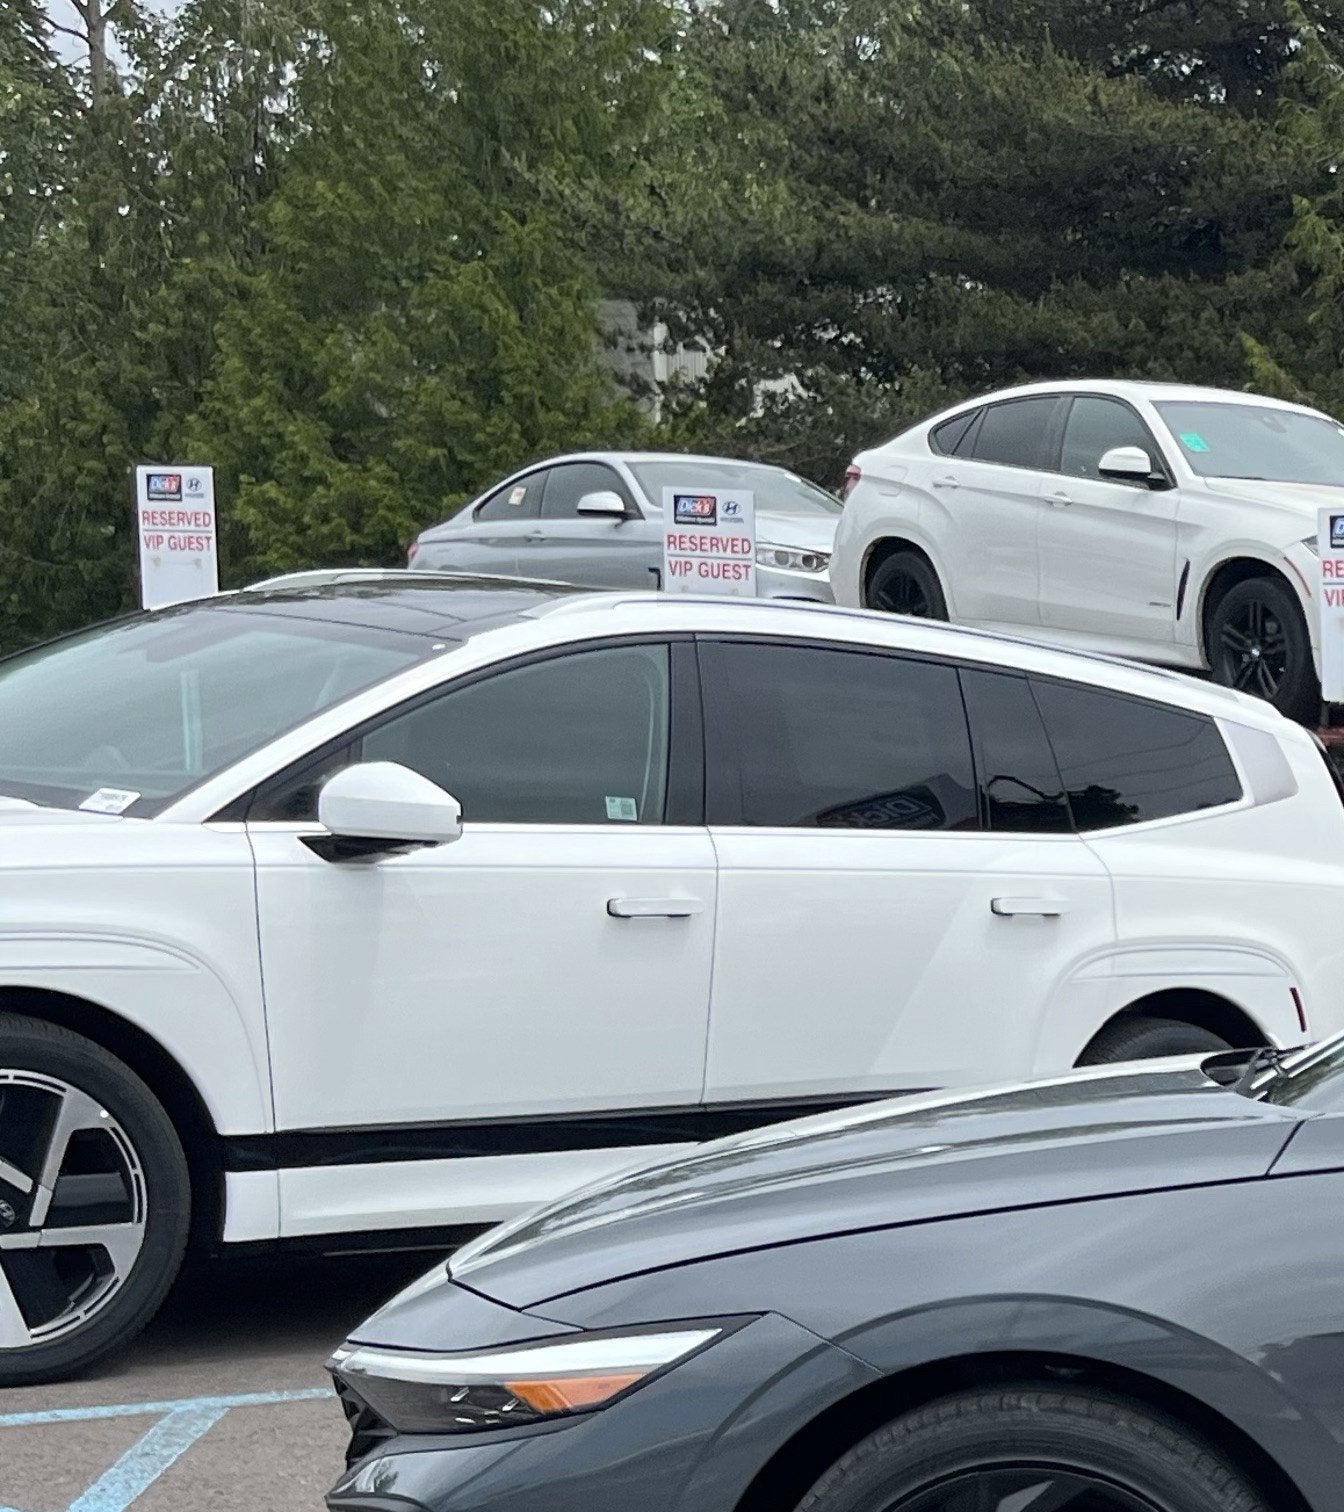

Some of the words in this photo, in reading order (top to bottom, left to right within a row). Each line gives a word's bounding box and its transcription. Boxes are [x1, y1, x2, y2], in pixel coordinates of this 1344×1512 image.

[142, 510, 211, 527] RESERVED
[144, 535, 164, 550] VIP
[168, 535, 212, 551] GUEST
[667, 534, 752, 554] RESERVED
[668, 560, 693, 577] VIP
[699, 562, 752, 581] GUEST
